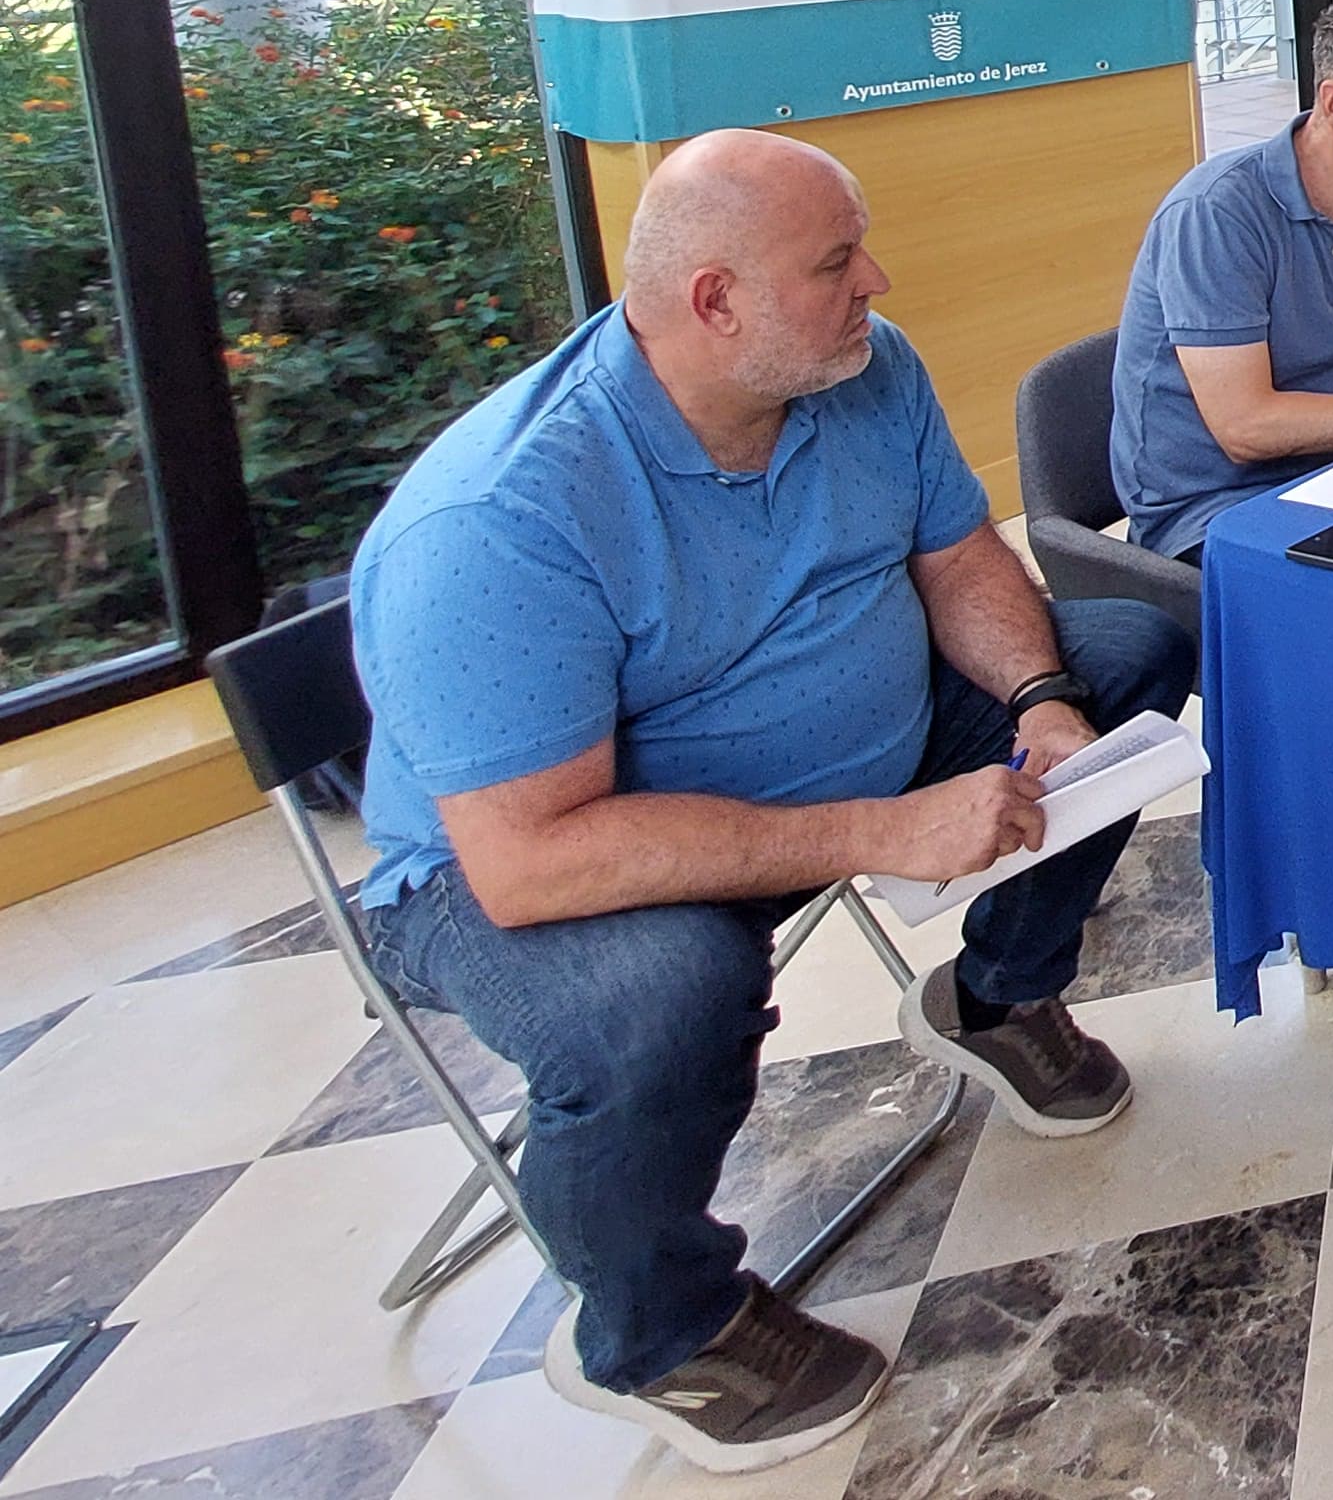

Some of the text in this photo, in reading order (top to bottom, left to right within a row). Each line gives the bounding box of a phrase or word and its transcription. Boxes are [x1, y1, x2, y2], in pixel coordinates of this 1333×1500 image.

[843, 57, 1048, 103] Ayuntamiento de Jerez
